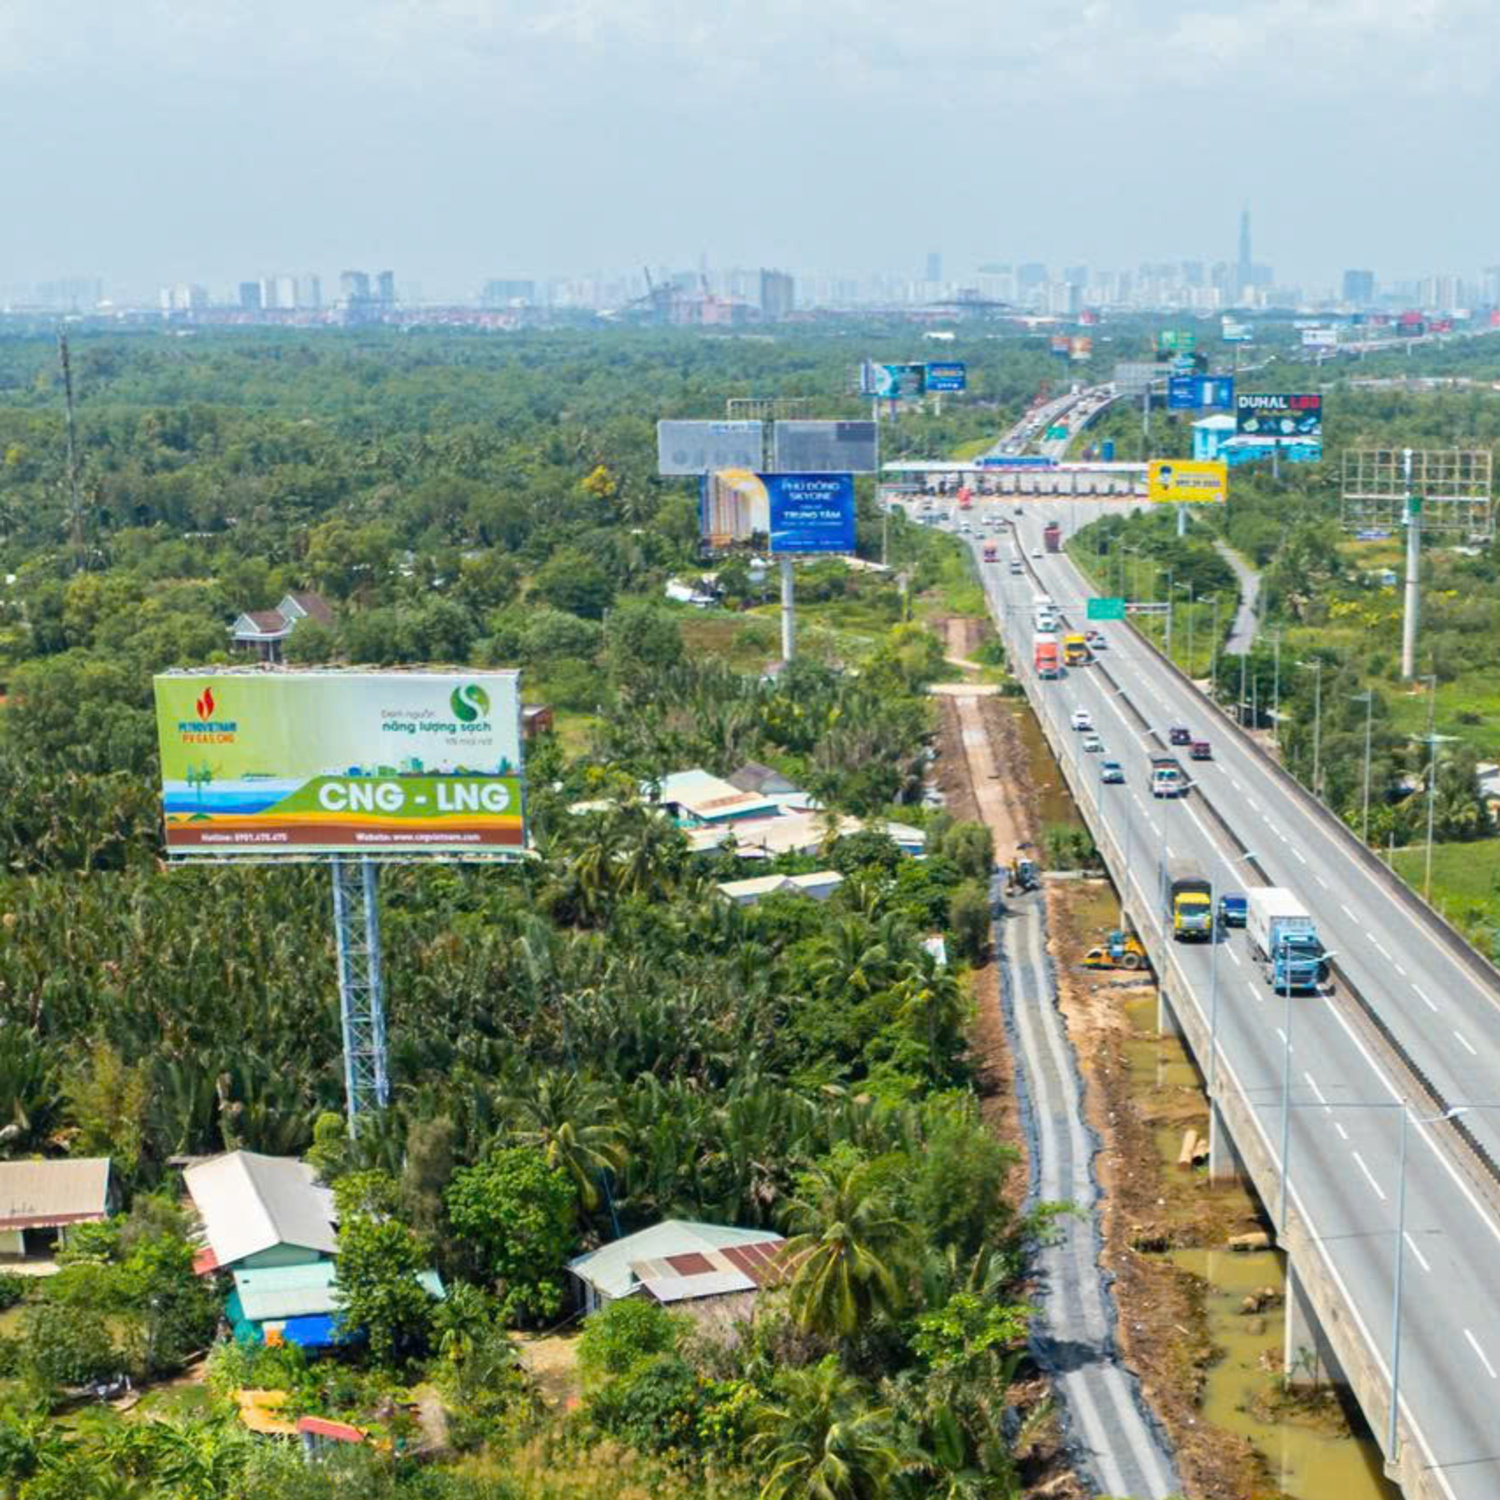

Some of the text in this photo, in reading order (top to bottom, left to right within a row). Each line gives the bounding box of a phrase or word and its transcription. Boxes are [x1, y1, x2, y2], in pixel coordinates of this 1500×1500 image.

[1239, 396, 1288, 408] DUHAL
[460, 721, 492, 735] sạch
[318, 783, 405, 811] CNG
[437, 783, 510, 811] LNG
